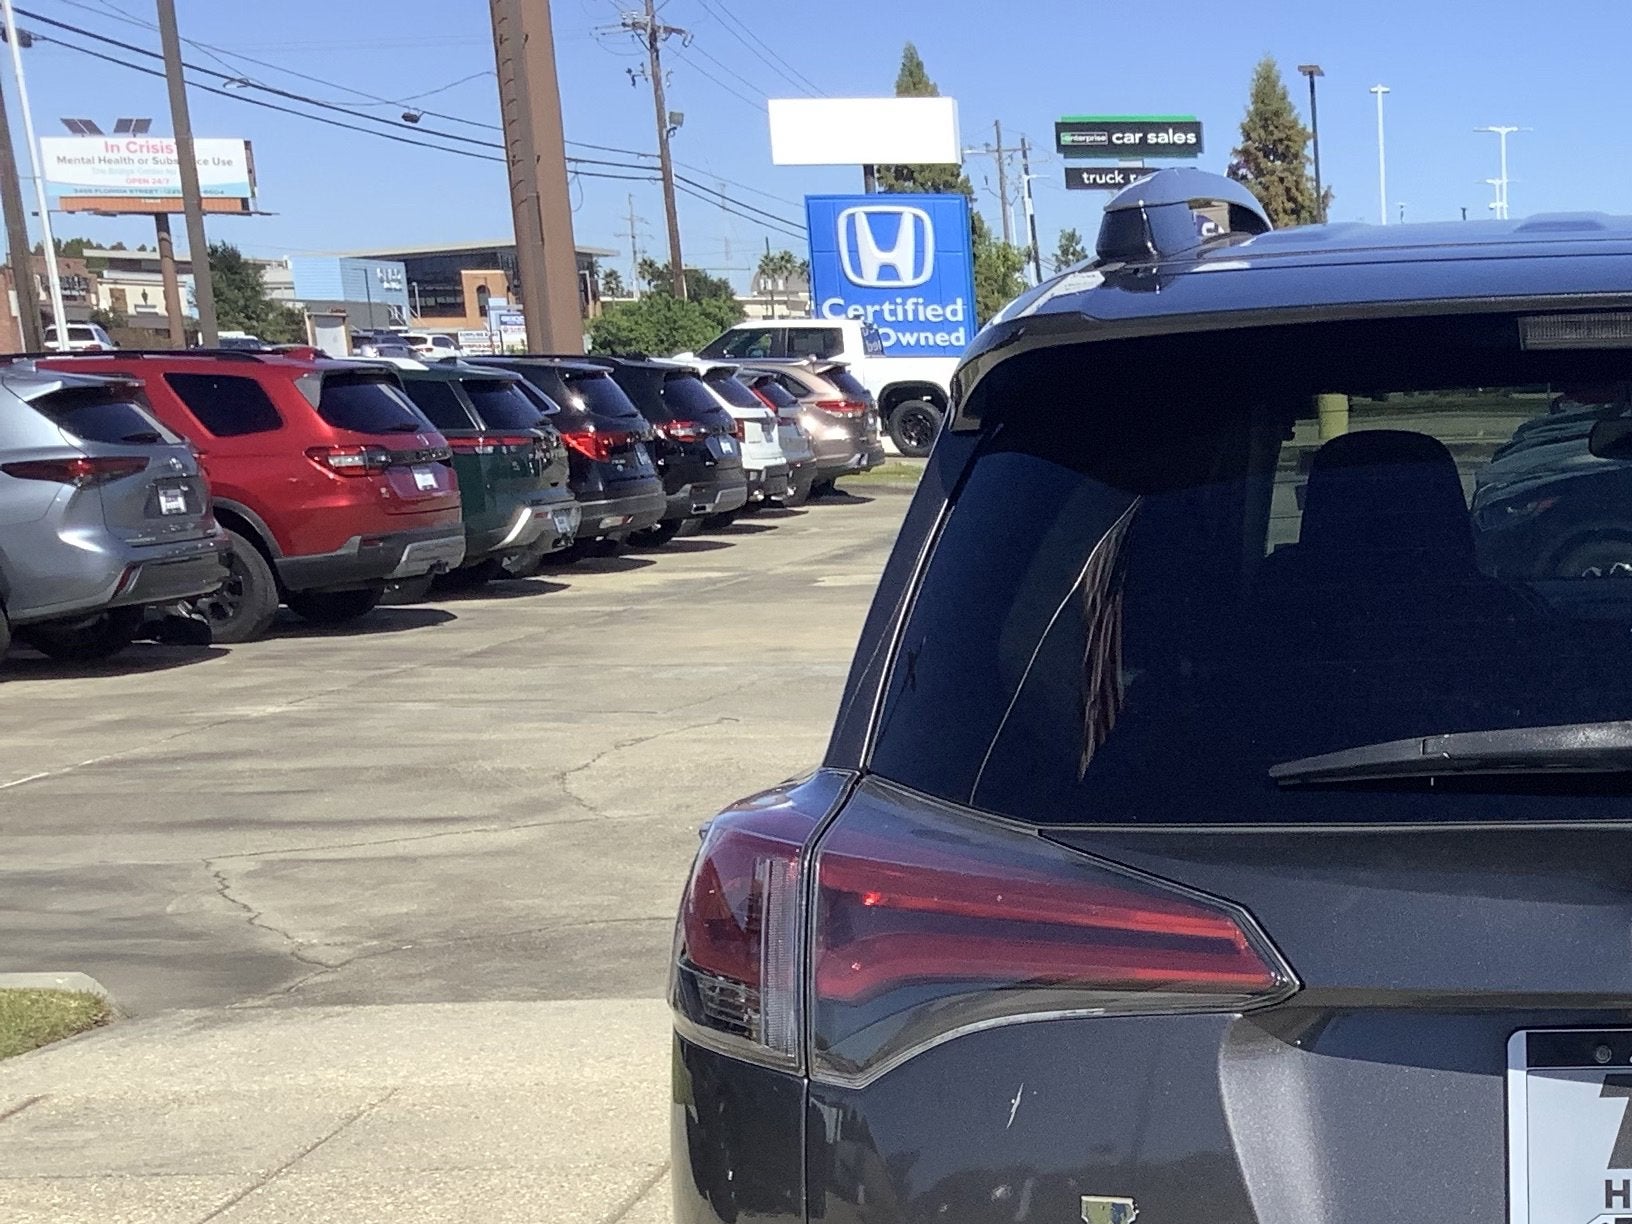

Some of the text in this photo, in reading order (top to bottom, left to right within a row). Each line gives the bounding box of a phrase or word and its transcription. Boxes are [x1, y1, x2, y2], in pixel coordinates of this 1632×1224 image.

[1062, 128, 1197, 144] enterprise car sales
[104, 141, 120, 153] In
[56, 156, 95, 165] Mental
[98, 156, 135, 165] Health
[151, 156, 209, 166] Subsce
[212, 157, 233, 166] Use
[1082, 170, 1124, 184] truck
[822, 297, 965, 322] Certified
[878, 327, 965, 347] Owned
